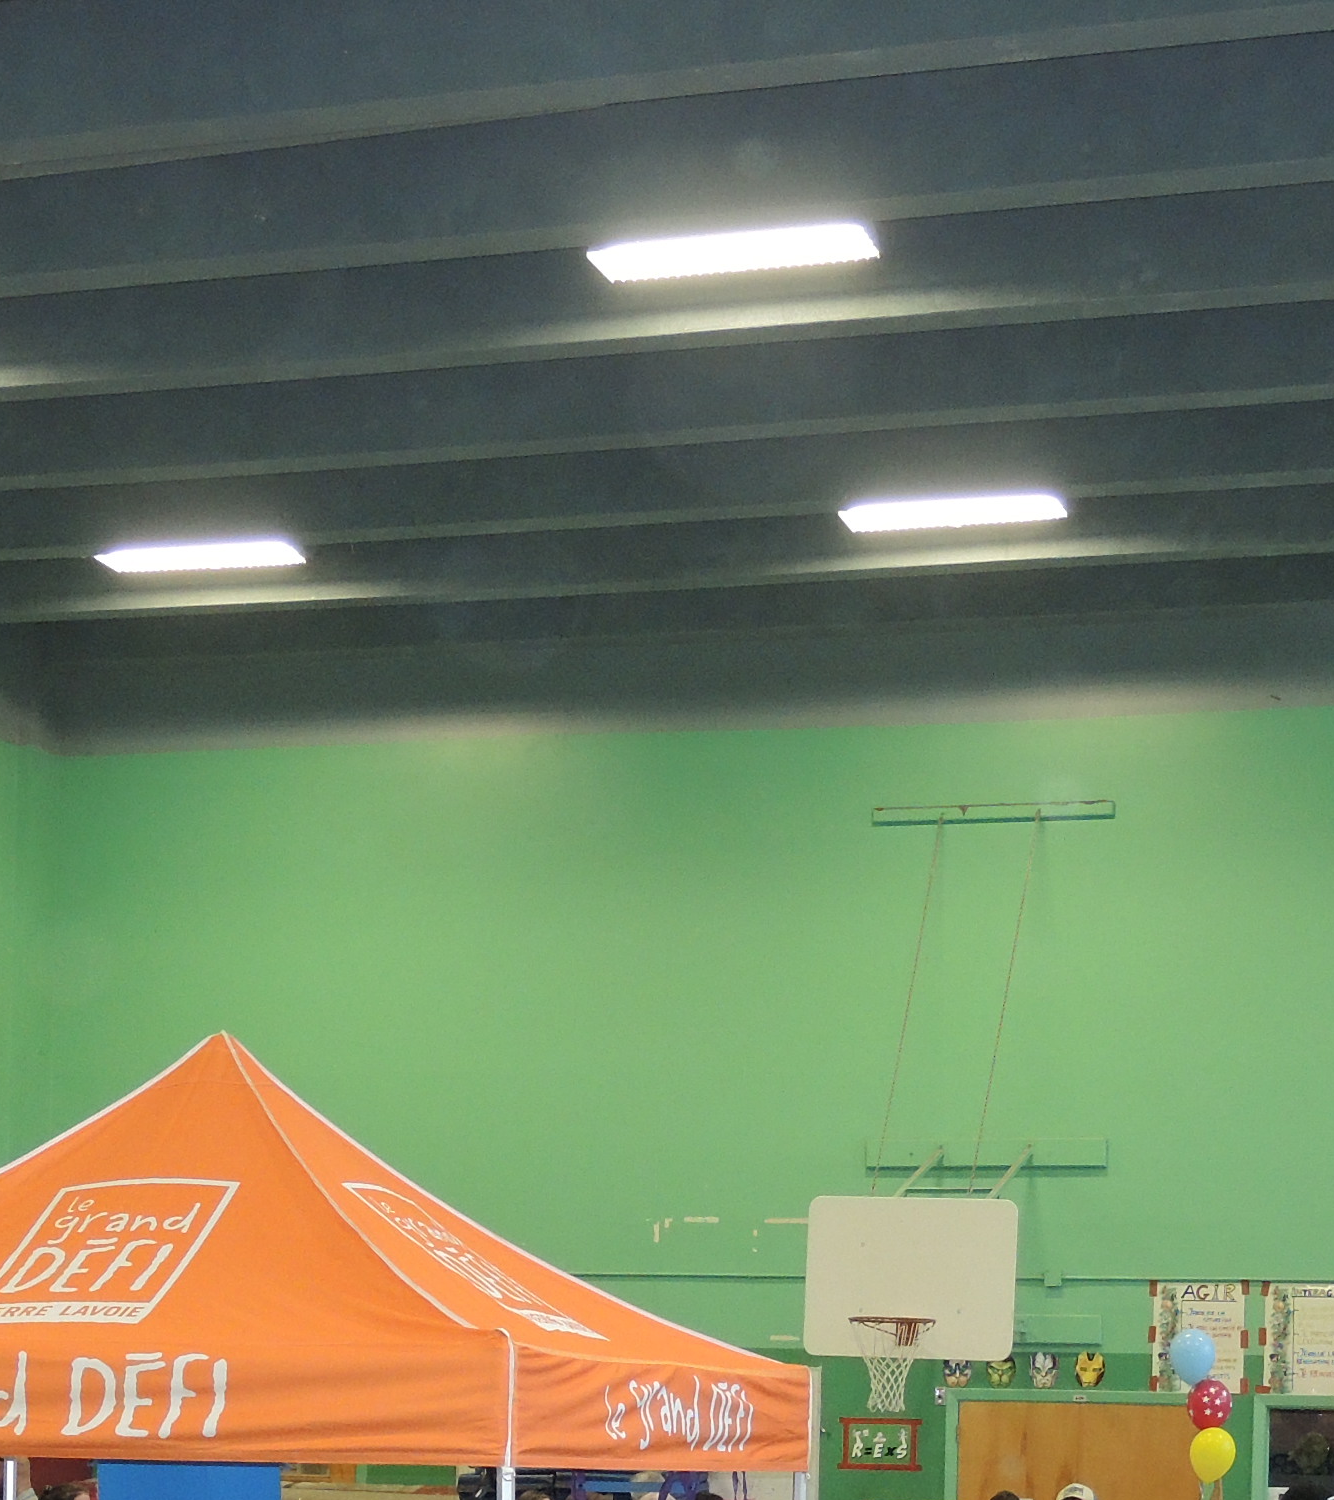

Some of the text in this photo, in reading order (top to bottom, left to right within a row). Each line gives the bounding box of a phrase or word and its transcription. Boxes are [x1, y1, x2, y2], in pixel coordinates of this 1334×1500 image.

[67, 1197, 95, 1212] le
[47, 1202, 201, 1245] grand
[1181, 1284, 1236, 1301] AGIR
[58, 1305, 146, 1318] LAVOIE
[60, 1351, 227, 1439] DÉFI
[604, 1385, 626, 1440] le
[629, 1375, 700, 1452] grand
